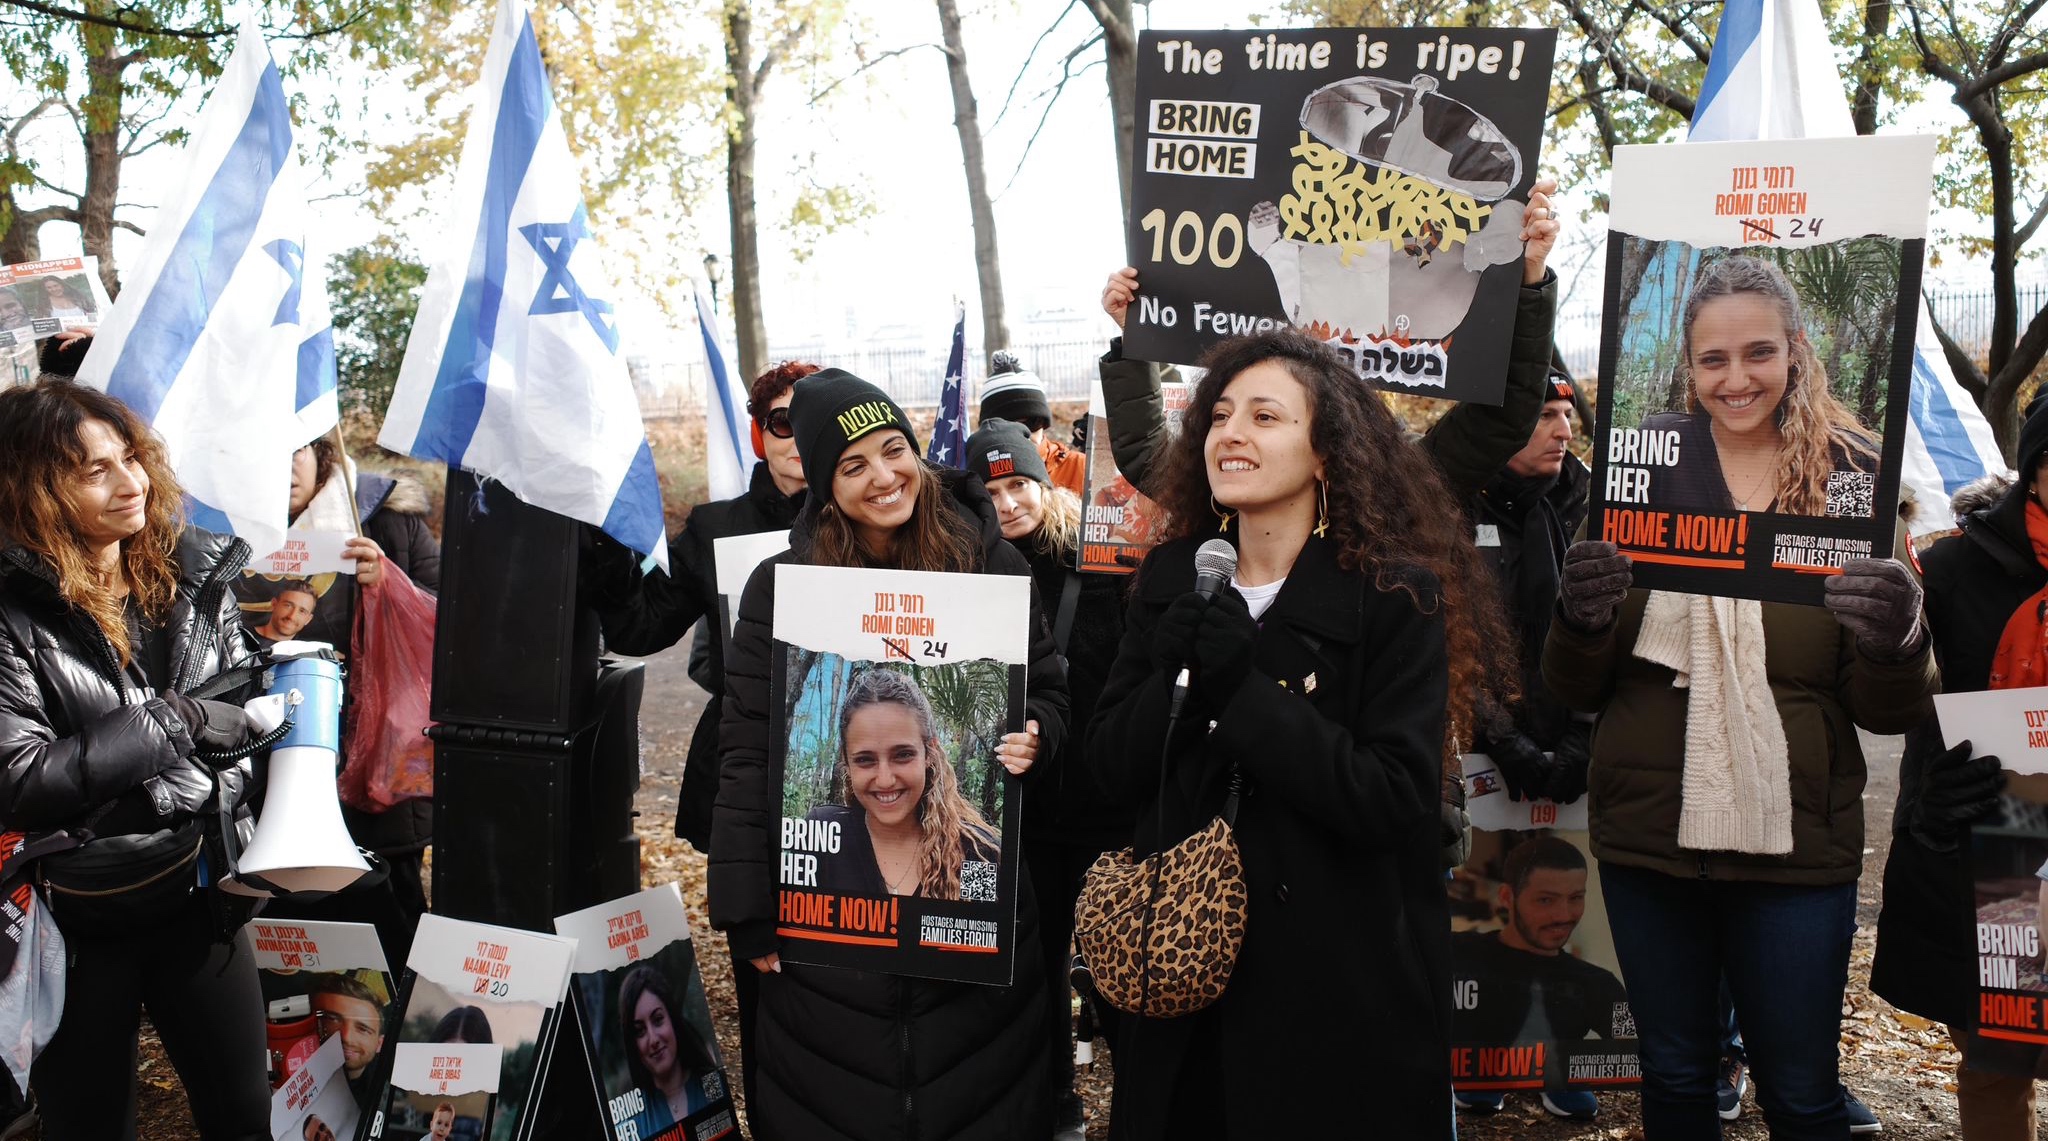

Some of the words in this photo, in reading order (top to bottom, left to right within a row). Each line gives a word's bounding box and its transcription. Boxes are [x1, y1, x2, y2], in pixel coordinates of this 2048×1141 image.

[1157, 41, 1223, 75] The
[1245, 34, 1331, 71] time
[1356, 34, 1388, 69] is
[1416, 34, 1526, 81] ripe!
[1157, 104, 1252, 135] BRING
[1154, 143, 1247, 174] HOME
[1732, 167, 1759, 191] גונן
[1764, 166, 1794, 190] רומי
[1715, 193, 1753, 216] ROMI
[1756, 192, 1807, 214] GONEN
[1142, 209, 1244, 269] 100
[1789, 217, 1824, 239] 24
[16, 260, 76, 271] KIDNAPPED
[1138, 296, 1177, 327] No
[1362, 347, 1443, 376] בשלה
[837, 401, 884, 436] NOW
[1608, 428, 1680, 466] BRING
[990, 458, 1013, 474] NOW
[1605, 467, 1650, 504] HER
[1086, 505, 1124, 524] BRING
[1084, 524, 1108, 542] HER
[1602, 509, 1668, 547] HOME
[1676, 514, 1749, 555] NOW!
[1775, 534, 1815, 548] HOSTAGES
[1817, 537, 1833, 550] AND
[1835, 538, 1872, 553] MISSING
[300, 552, 309, 561] OR
[1083, 545, 1118, 564] HOME
[1773, 547, 1824, 567] FAMILIES
[875, 592, 895, 614] גונן
[898, 593, 924, 613] רומי
[862, 614, 892, 634] ROMI
[895, 617, 934, 637] GONEN
[923, 640, 948, 659] 24
[1530, 803, 1557, 825] (19)
[781, 818, 841, 854] BRING
[779, 853, 818, 887] HER
[778, 891, 834, 927] HOME
[839, 896, 898, 935] NOW!
[921, 914, 954, 930] HOSTAGES
[955, 918, 968, 930] AND
[969, 919, 998, 933] MISSING
[256, 939, 302, 953] AVINATAN
[303, 941, 318, 953] OR
[608, 930, 632, 949] KARINA
[631, 924, 649, 941] ARIEV
[920, 926, 961, 945] FAMILIES
[963, 930, 997, 949] FORUM
[1977, 923, 2039, 957] BRING
[304, 954, 320, 967] 31
[463, 957, 490, 976] NAAMA
[490, 962, 511, 979] LEVY
[1979, 956, 2017, 989] HIM
[491, 981, 508, 997] 20
[1980, 993, 2037, 1029] HOME
[1479, 1042, 1545, 1077] NOW!
[1569, 1055, 1604, 1065] HOSTAGES
[1606, 1055, 1620, 1064] AND
[429, 1069, 443, 1079] ARIEL
[445, 1070, 461, 1080] BIBAS
[1569, 1065, 1614, 1079] FAMILIES
[1616, 1064, 1643, 1078] FORU
[608, 1087, 645, 1125] BRING
